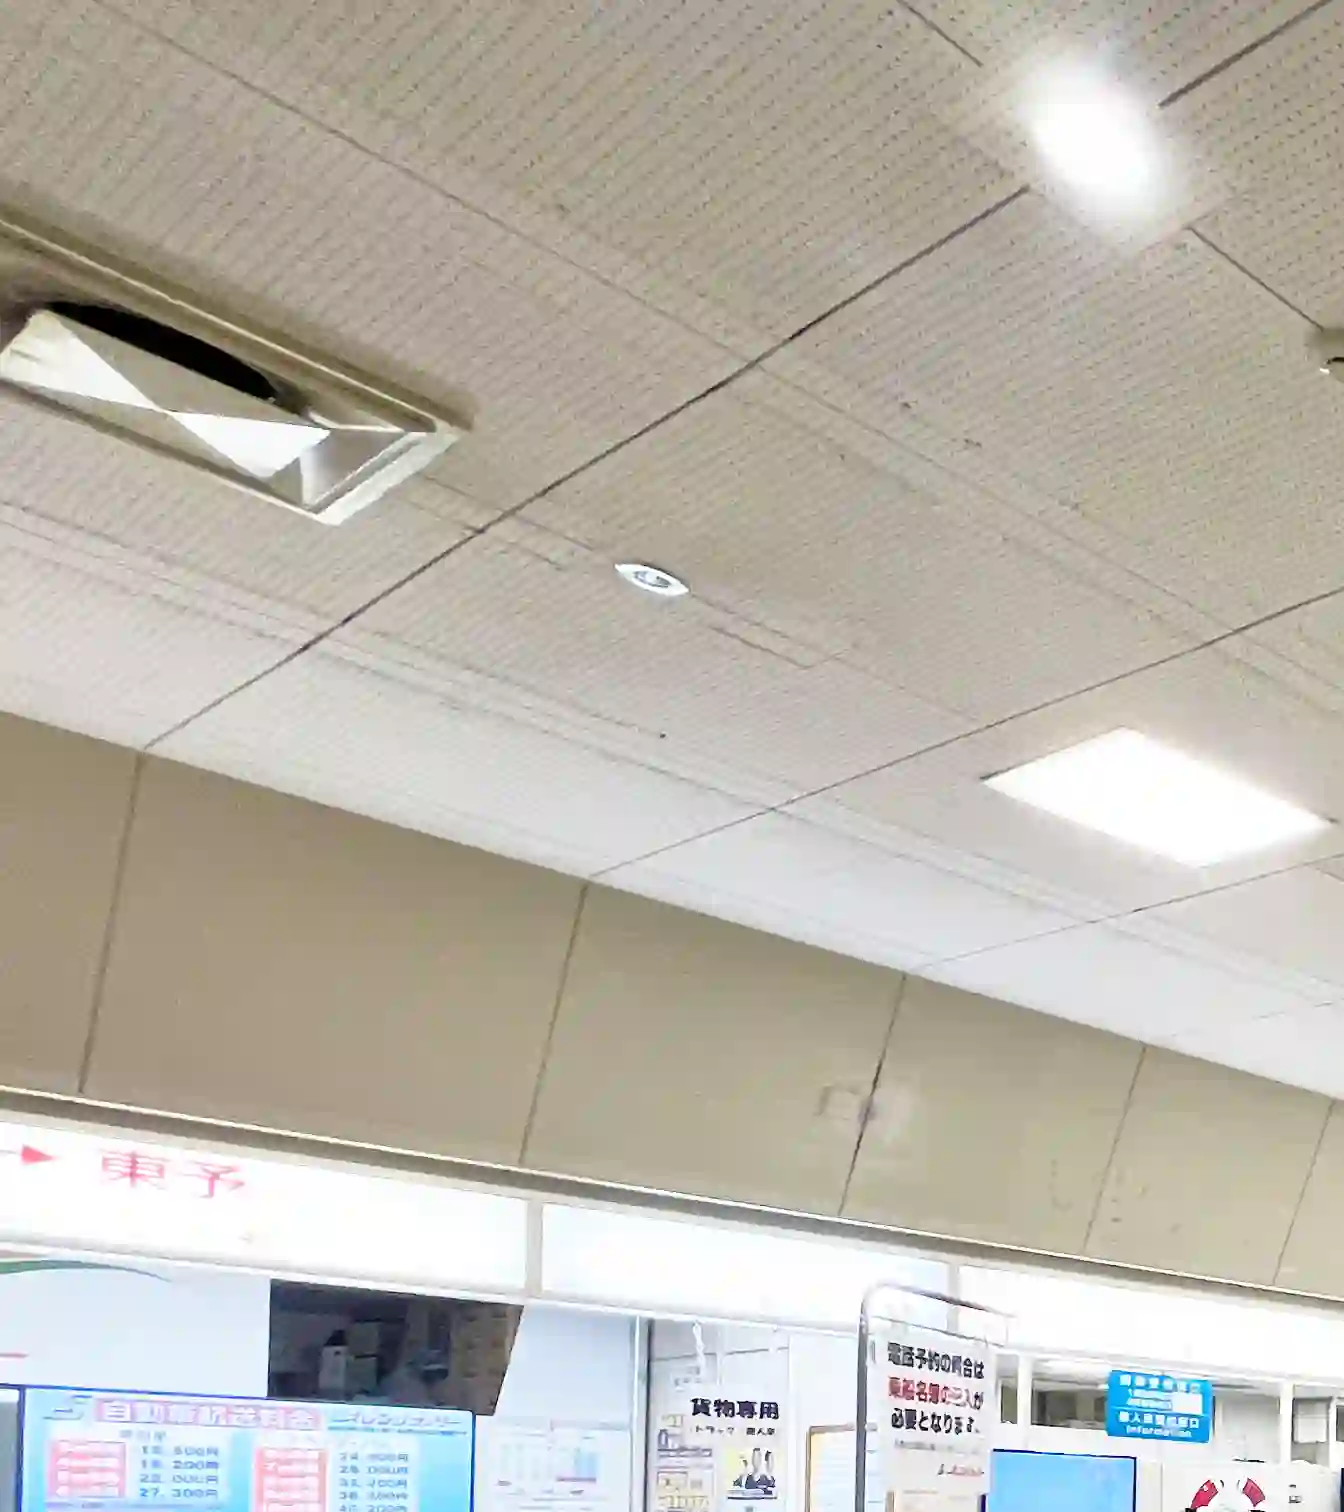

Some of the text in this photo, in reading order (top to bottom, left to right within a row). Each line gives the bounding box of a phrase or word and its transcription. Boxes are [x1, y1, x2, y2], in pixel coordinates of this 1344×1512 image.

[101, 1149, 245, 1200] 東予
[690, 1397, 780, 1420] 貨物専用
